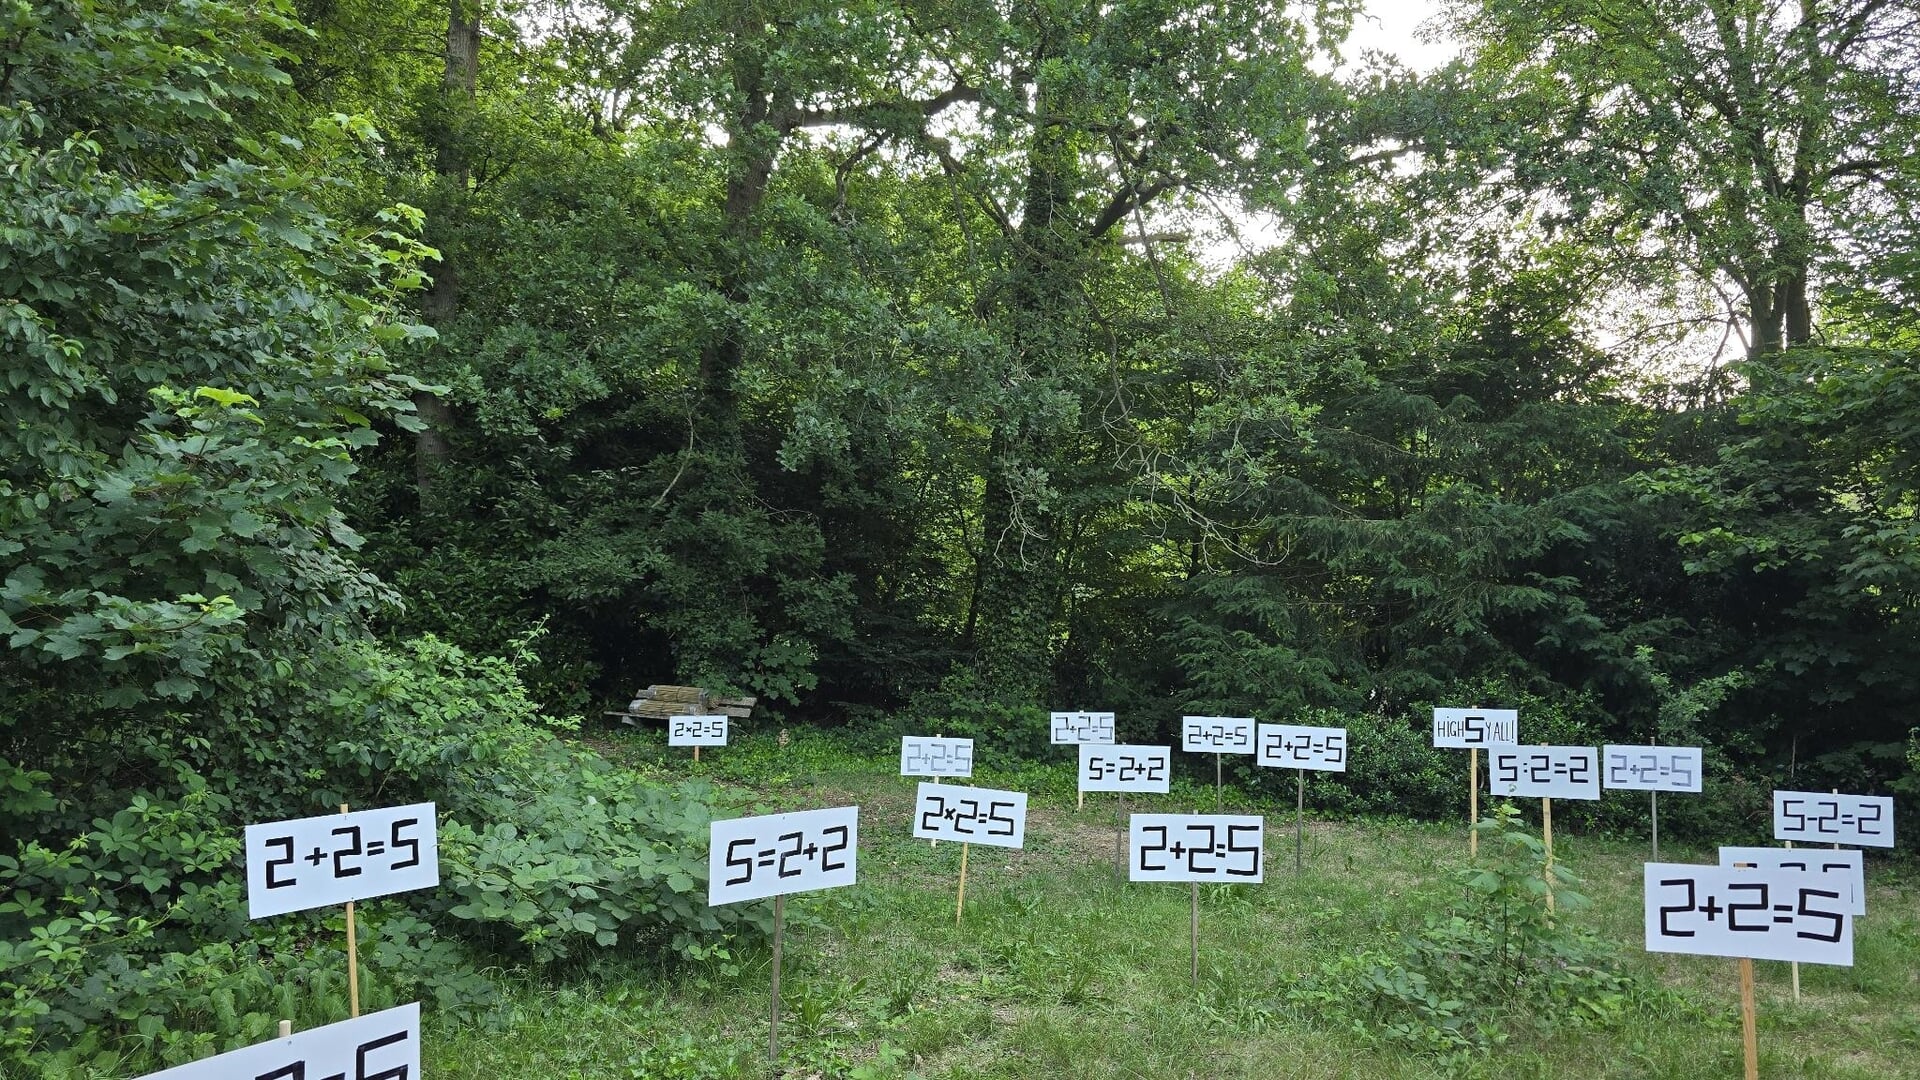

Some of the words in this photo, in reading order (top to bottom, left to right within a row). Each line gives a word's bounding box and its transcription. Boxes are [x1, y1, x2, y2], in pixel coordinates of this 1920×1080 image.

[1055, 716, 1113, 741] 2+2=5
[1188, 725, 1247, 745] 2+2=5
[1465, 717, 1485, 743] 5
[907, 744, 971, 773] 2+2=5
[1266, 734, 1342, 762] 2+2=5
[1089, 757, 1164, 781] 5=2+2
[1498, 756, 1588, 783] 5:2=2
[1611, 754, 1692, 787] 2+2=5
[1783, 800, 1881, 834] 5-2=2
[265, 818, 419, 889] 2+2=5
[726, 826, 849, 886] 5=2+2
[1141, 825, 1259, 876] 2+2=5
[1660, 878, 1843, 943] 2+2=5
